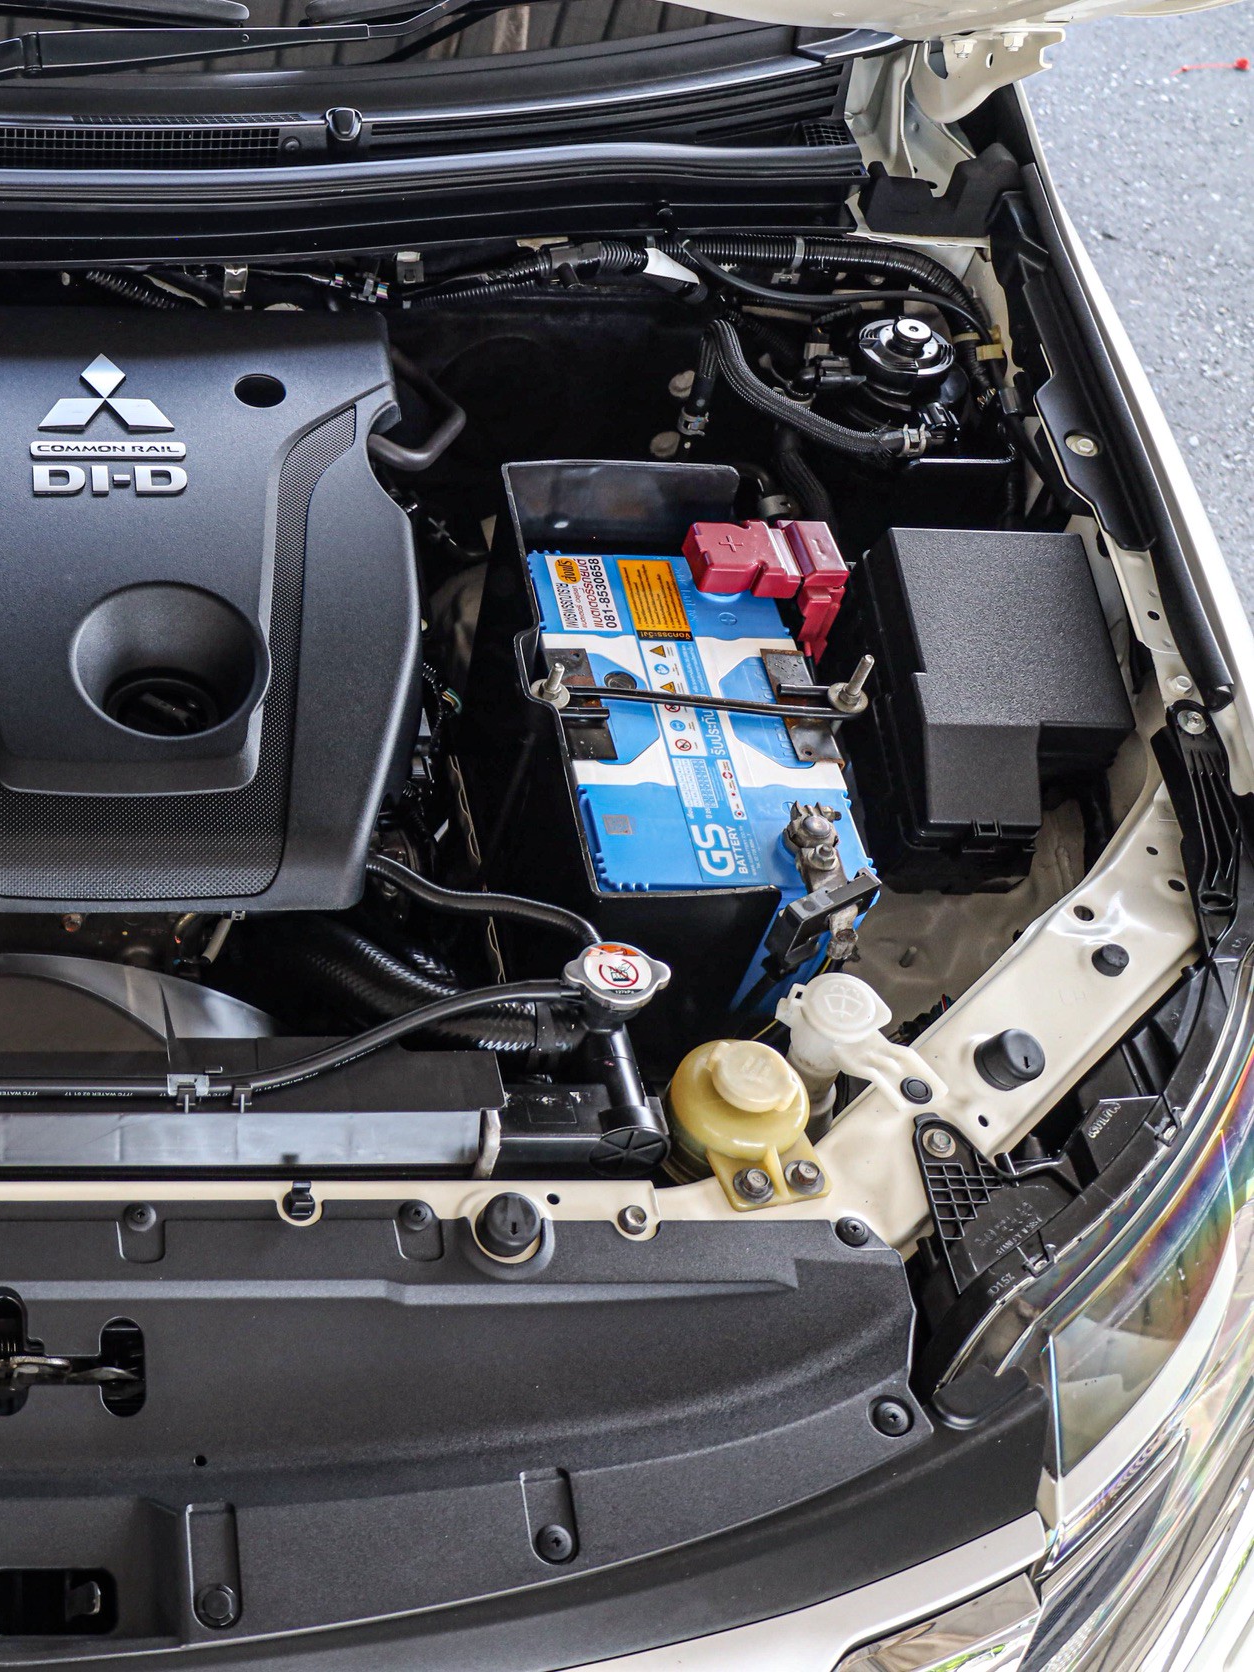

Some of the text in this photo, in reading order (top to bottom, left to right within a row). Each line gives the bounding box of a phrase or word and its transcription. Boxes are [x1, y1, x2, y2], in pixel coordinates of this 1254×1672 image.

[37, 444, 126, 453] COMMON
[32, 465, 188, 495] DI-D
[556, 559, 577, 582] ส่งฟรี
[587, 558, 617, 628] 081-8530658
[690, 823, 735, 876] GS
[725, 825, 749, 874] BATTERY
